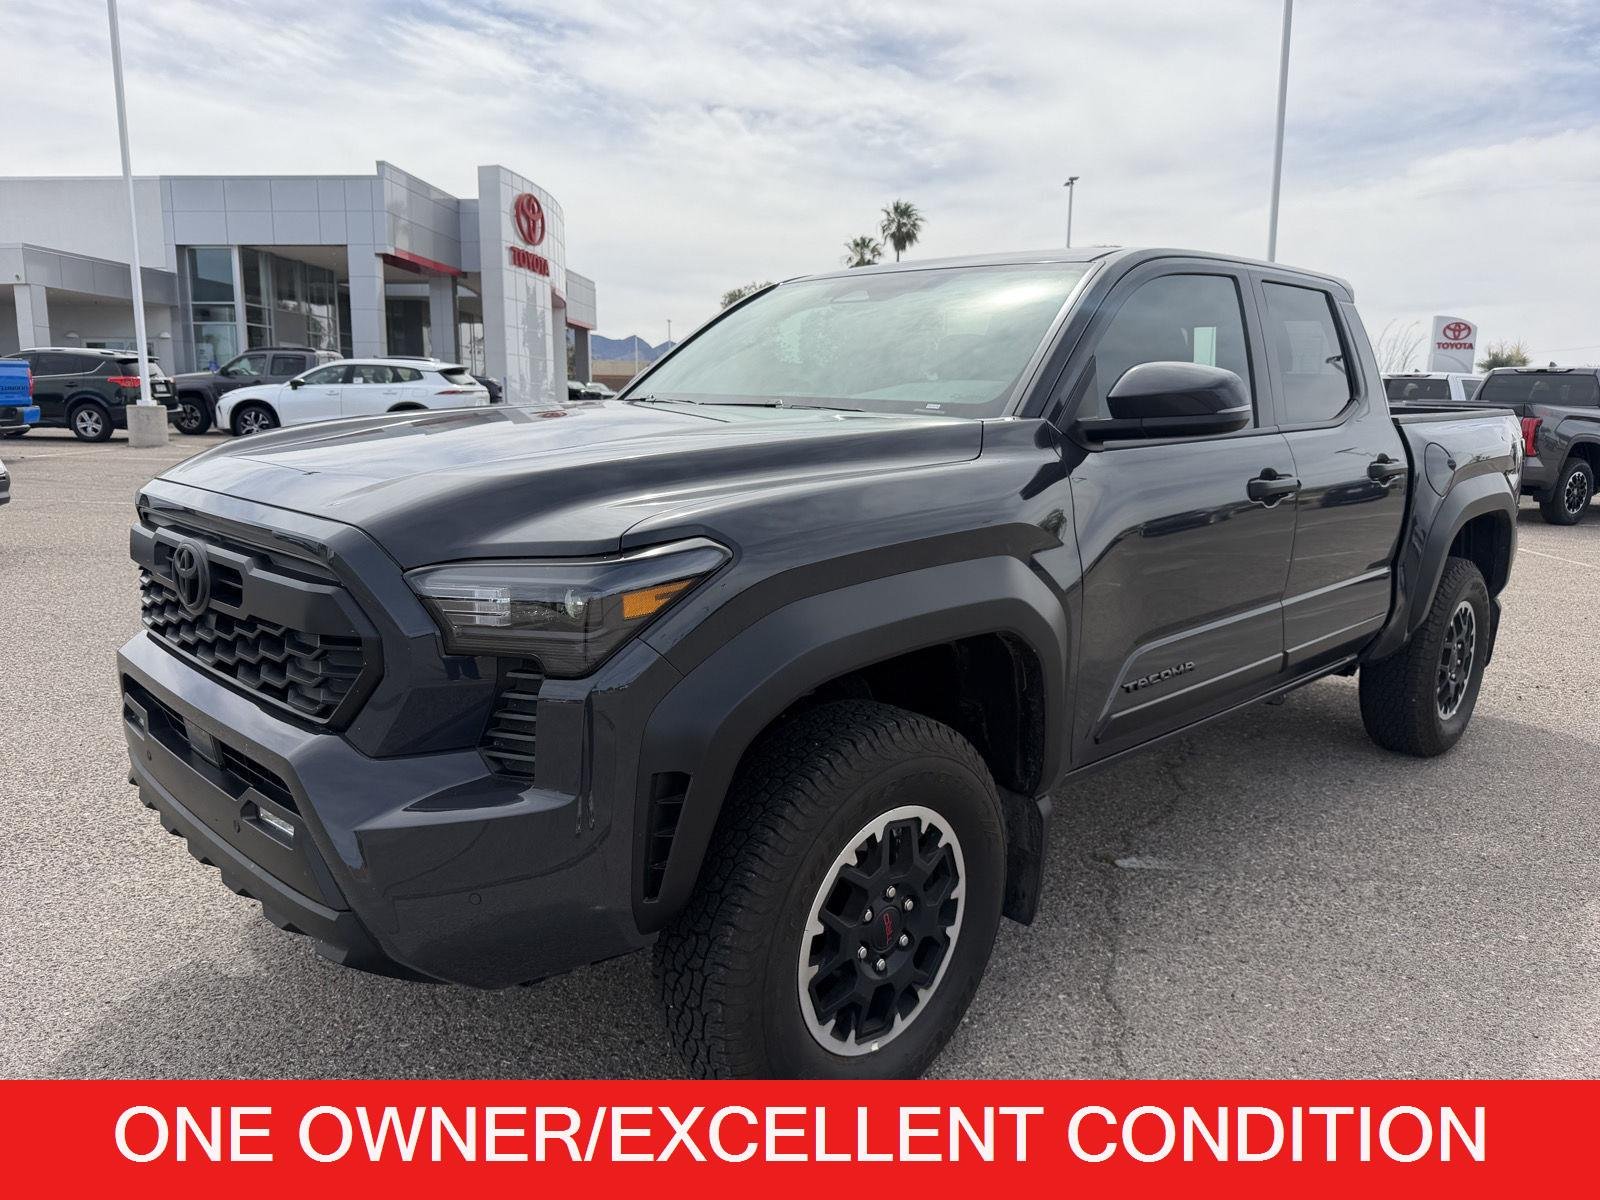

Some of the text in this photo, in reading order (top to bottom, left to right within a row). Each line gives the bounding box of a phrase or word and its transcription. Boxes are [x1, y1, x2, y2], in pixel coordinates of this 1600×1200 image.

[510, 246, 550, 277] TOYOTA
[1436, 342, 1474, 350] TOYOTA
[1121, 661, 1196, 693] TACOMA
